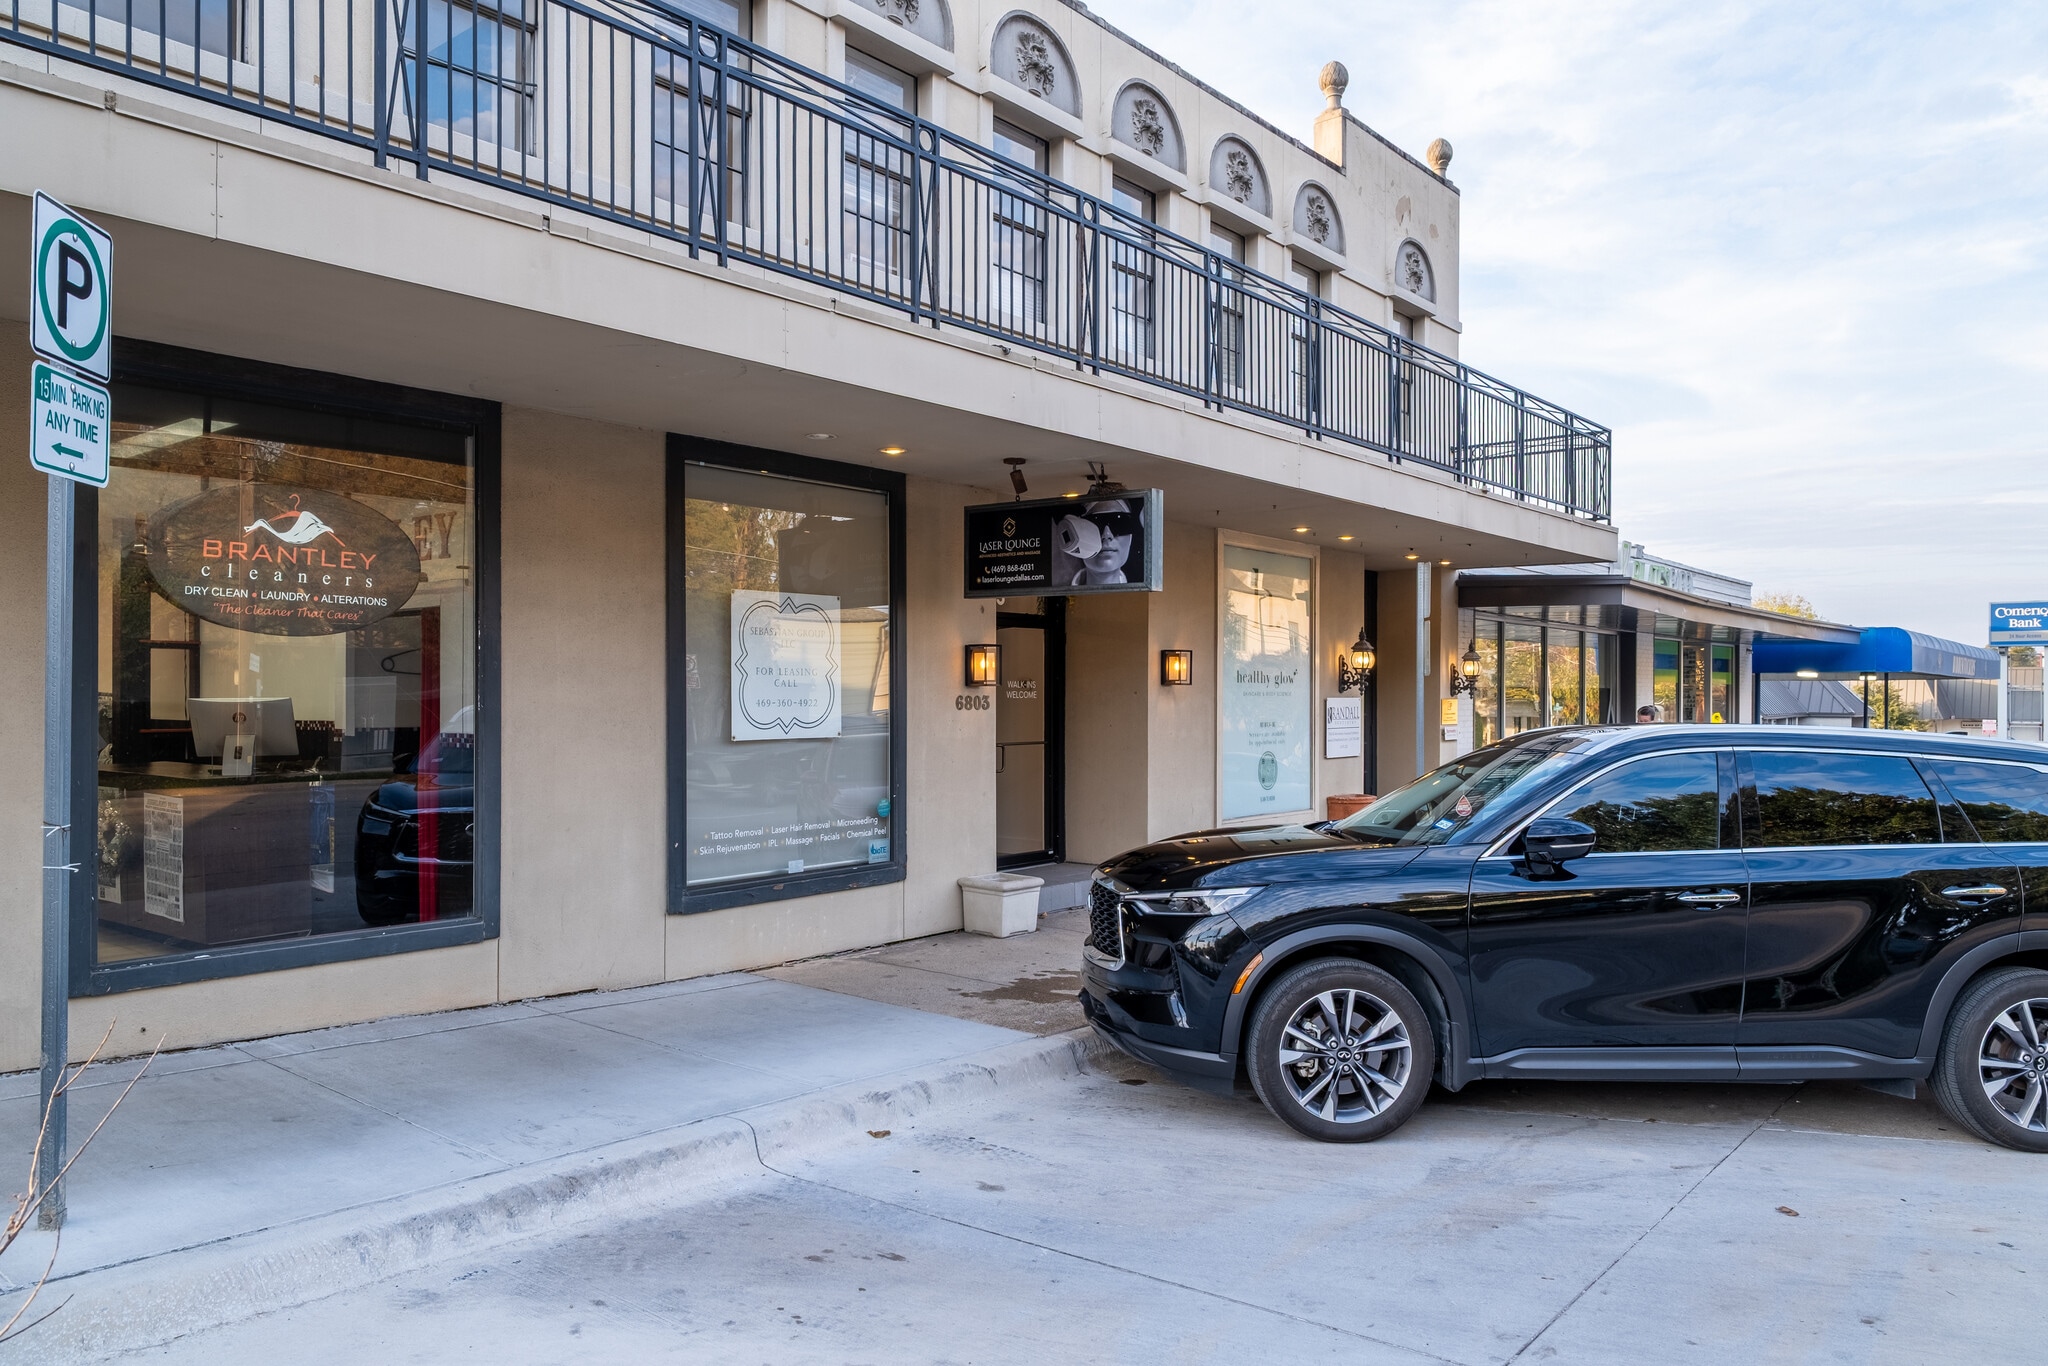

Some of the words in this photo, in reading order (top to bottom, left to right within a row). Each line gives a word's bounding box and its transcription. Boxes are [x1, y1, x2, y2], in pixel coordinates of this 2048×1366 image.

[57, 239, 93, 330] P
[39, 377, 50, 399] 15
[51, 382, 68, 406] MIN.
[72, 390, 105, 420] PARKNG
[45, 409, 71, 434] ANY
[73, 418, 99, 444] TIME
[979, 541, 1003, 553] LASER
[1004, 538, 1041, 551] LOUNGE
[202, 538, 378, 571] BRANTLEY
[200, 563, 374, 588] cleaners
[991, 564, 1007, 574] (469)
[1007, 563, 1035, 572] 868-6031
[981, 573, 1045, 584] laserloungedallas.com
[184, 585, 209, 596] DRY
[211, 587, 249, 598] CLEAN
[260, 590, 311, 602] LAUNDRY
[320, 594, 388, 607] ALTERATIONS
[244, 604, 294, 617] Cleaner
[297, 607, 324, 619] That
[1994, 606, 2048, 619] Comeric
[2008, 617, 2043, 628] Bank
[755, 667, 774, 676] FOR
[778, 667, 818, 677] LEASING
[1236, 669, 1270, 688] healthy
[1274, 671, 1294, 689] glow
[774, 679, 798, 687] CALL
[1007, 680, 1037, 689] WALK-INS
[1006, 690, 1037, 699] WELCOME
[755, 698, 818, 707] 469-360-4922
[955, 694, 991, 711] 6803
[710, 831, 733, 840] Tattoo
[734, 826, 764, 838] Removal
[771, 825, 789, 834] Laser
[789, 823, 803, 832] Hair
[804, 820, 831, 831] Removal
[836, 816, 879, 827] Microneedling
[699, 844, 715, 856] Skin
[716, 841, 761, 855] Rejuvenation
[767, 838, 779, 847] IPL
[785, 836, 813, 846] Massage
[820, 832, 840, 842] Facials
[846, 828, 873, 839] Chemical
[874, 826, 887, 835] Peel
